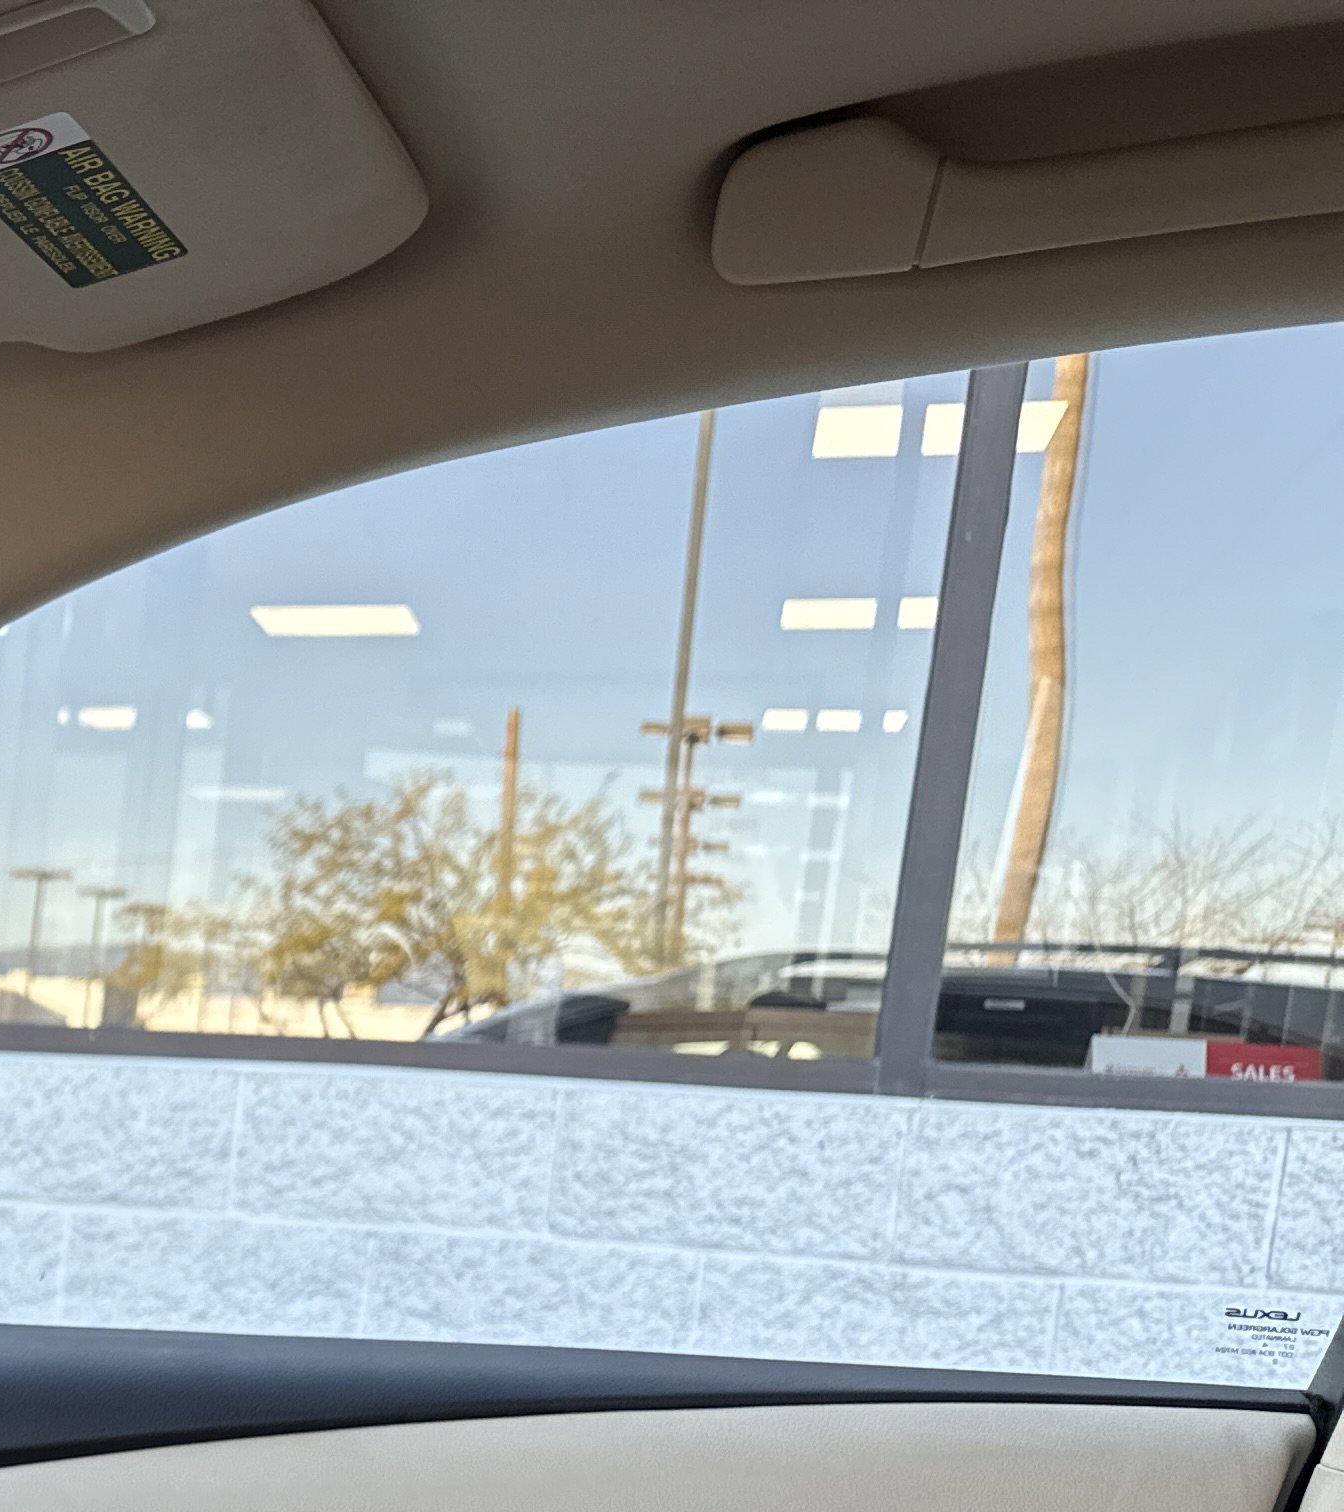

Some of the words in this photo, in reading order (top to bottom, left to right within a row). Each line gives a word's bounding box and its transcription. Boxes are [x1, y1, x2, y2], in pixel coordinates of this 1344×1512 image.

[63, 184, 88, 200] FLIP
[58, 146, 103, 174] AIR
[83, 170, 129, 204] BAG
[111, 199, 180, 260] WARNING
[1231, 1062, 1295, 1083] SALES
